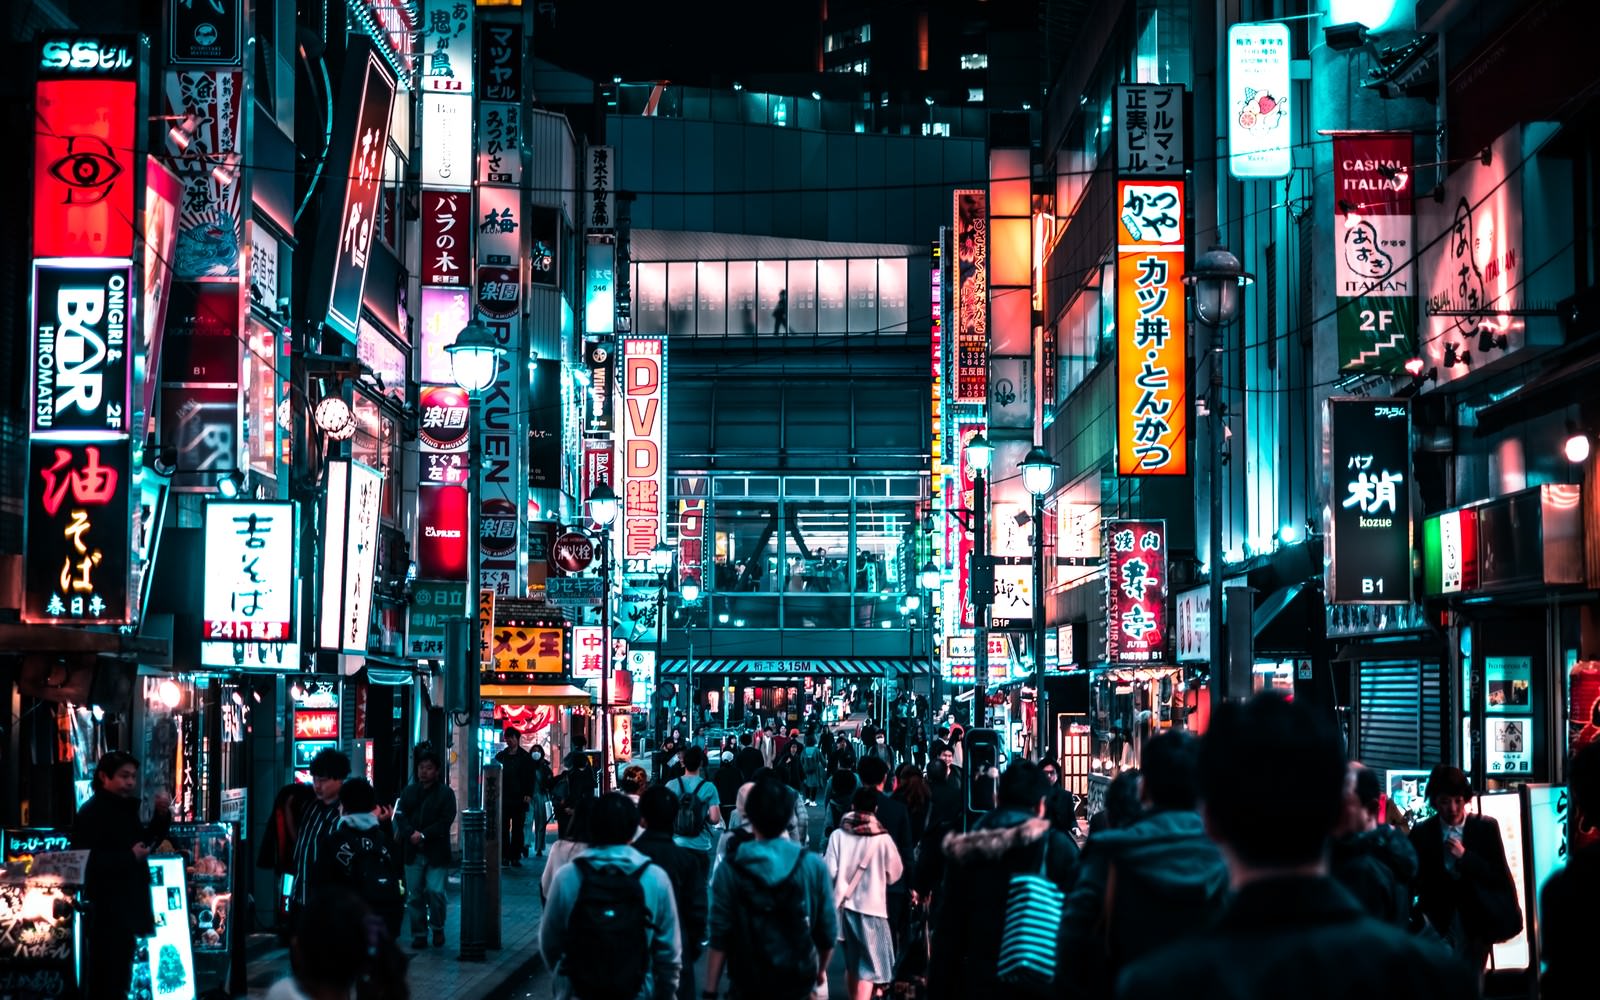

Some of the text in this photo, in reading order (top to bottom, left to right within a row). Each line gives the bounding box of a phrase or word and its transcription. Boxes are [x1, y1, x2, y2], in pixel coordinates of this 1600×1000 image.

[431, 10, 454, 78] 鬼が島
[42, 41, 133, 70] SSビル
[490, 27, 514, 84] マツヤ
[486, 87, 516, 99] ビル
[1126, 89, 1148, 172] 正実ビル
[1153, 88, 1174, 173] ブルマン
[487, 111, 504, 172] みつひさ
[1344, 178, 1408, 190] ITALIA
[480, 208, 519, 233] 梅
[433, 195, 460, 272] バラの木
[482, 282, 519, 301] 楽園
[1344, 281, 1407, 292] ITALIAN
[1359, 311, 1393, 332] 2F
[55, 287, 107, 415] BAR
[106, 275, 126, 429] ONIGIRI & 2F
[193, 367, 206, 375] B1
[960, 368, 984, 376] 五反田
[1134, 256, 1172, 469] カツ丼・とんかつ
[36, 325, 55, 428] HIROMATSU
[485, 321, 510, 483] RAKUEN
[423, 406, 468, 428] 楽園
[428, 454, 462, 465] すぐ 角
[627, 358, 659, 556] DVD鑑賞
[1348, 455, 1373, 469] パブ
[1342, 471, 1403, 513] 梢
[40, 446, 118, 592] 油そば
[480, 519, 516, 538] 楽園
[1360, 517, 1392, 528] kozue
[557, 544, 591, 564] 消火栓
[232, 513, 274, 617] 吉そば
[500, 571, 511, 580] 角
[562, 582, 603, 596] セキネ
[1362, 579, 1384, 593] B1
[47, 595, 106, 616] 春日亭
[434, 591, 464, 606] 日立
[992, 618, 1010, 628] B1F
[777, 661, 811, 671] 3.15M
[621, 719, 631, 756] らーめん
